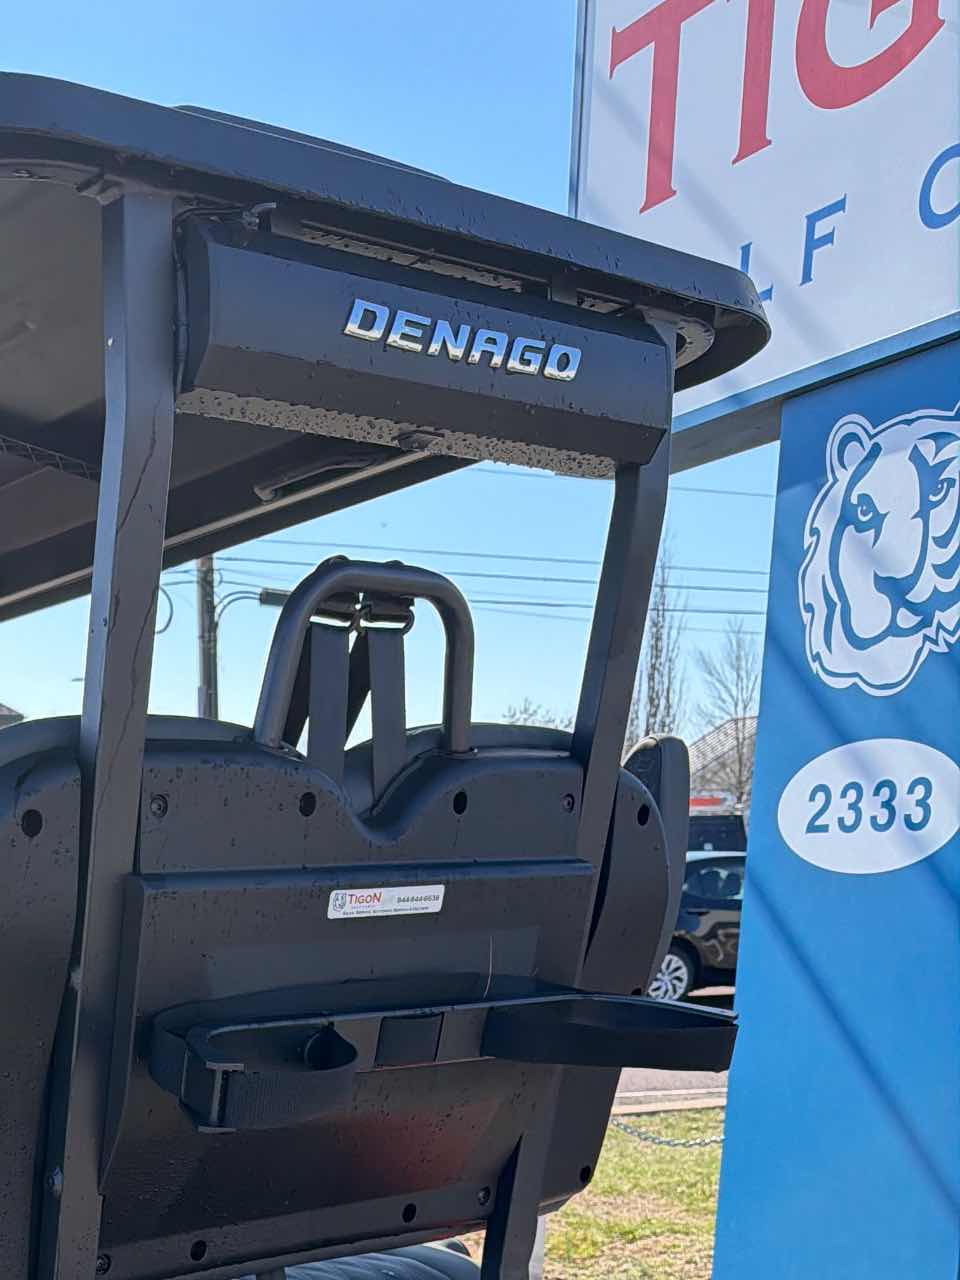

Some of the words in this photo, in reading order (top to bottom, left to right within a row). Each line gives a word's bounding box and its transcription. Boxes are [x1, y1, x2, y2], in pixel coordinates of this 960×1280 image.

[343, 298, 583, 382] DENAGO
[805, 776, 933, 834] 2333
[348, 891, 382, 905] TIGON
